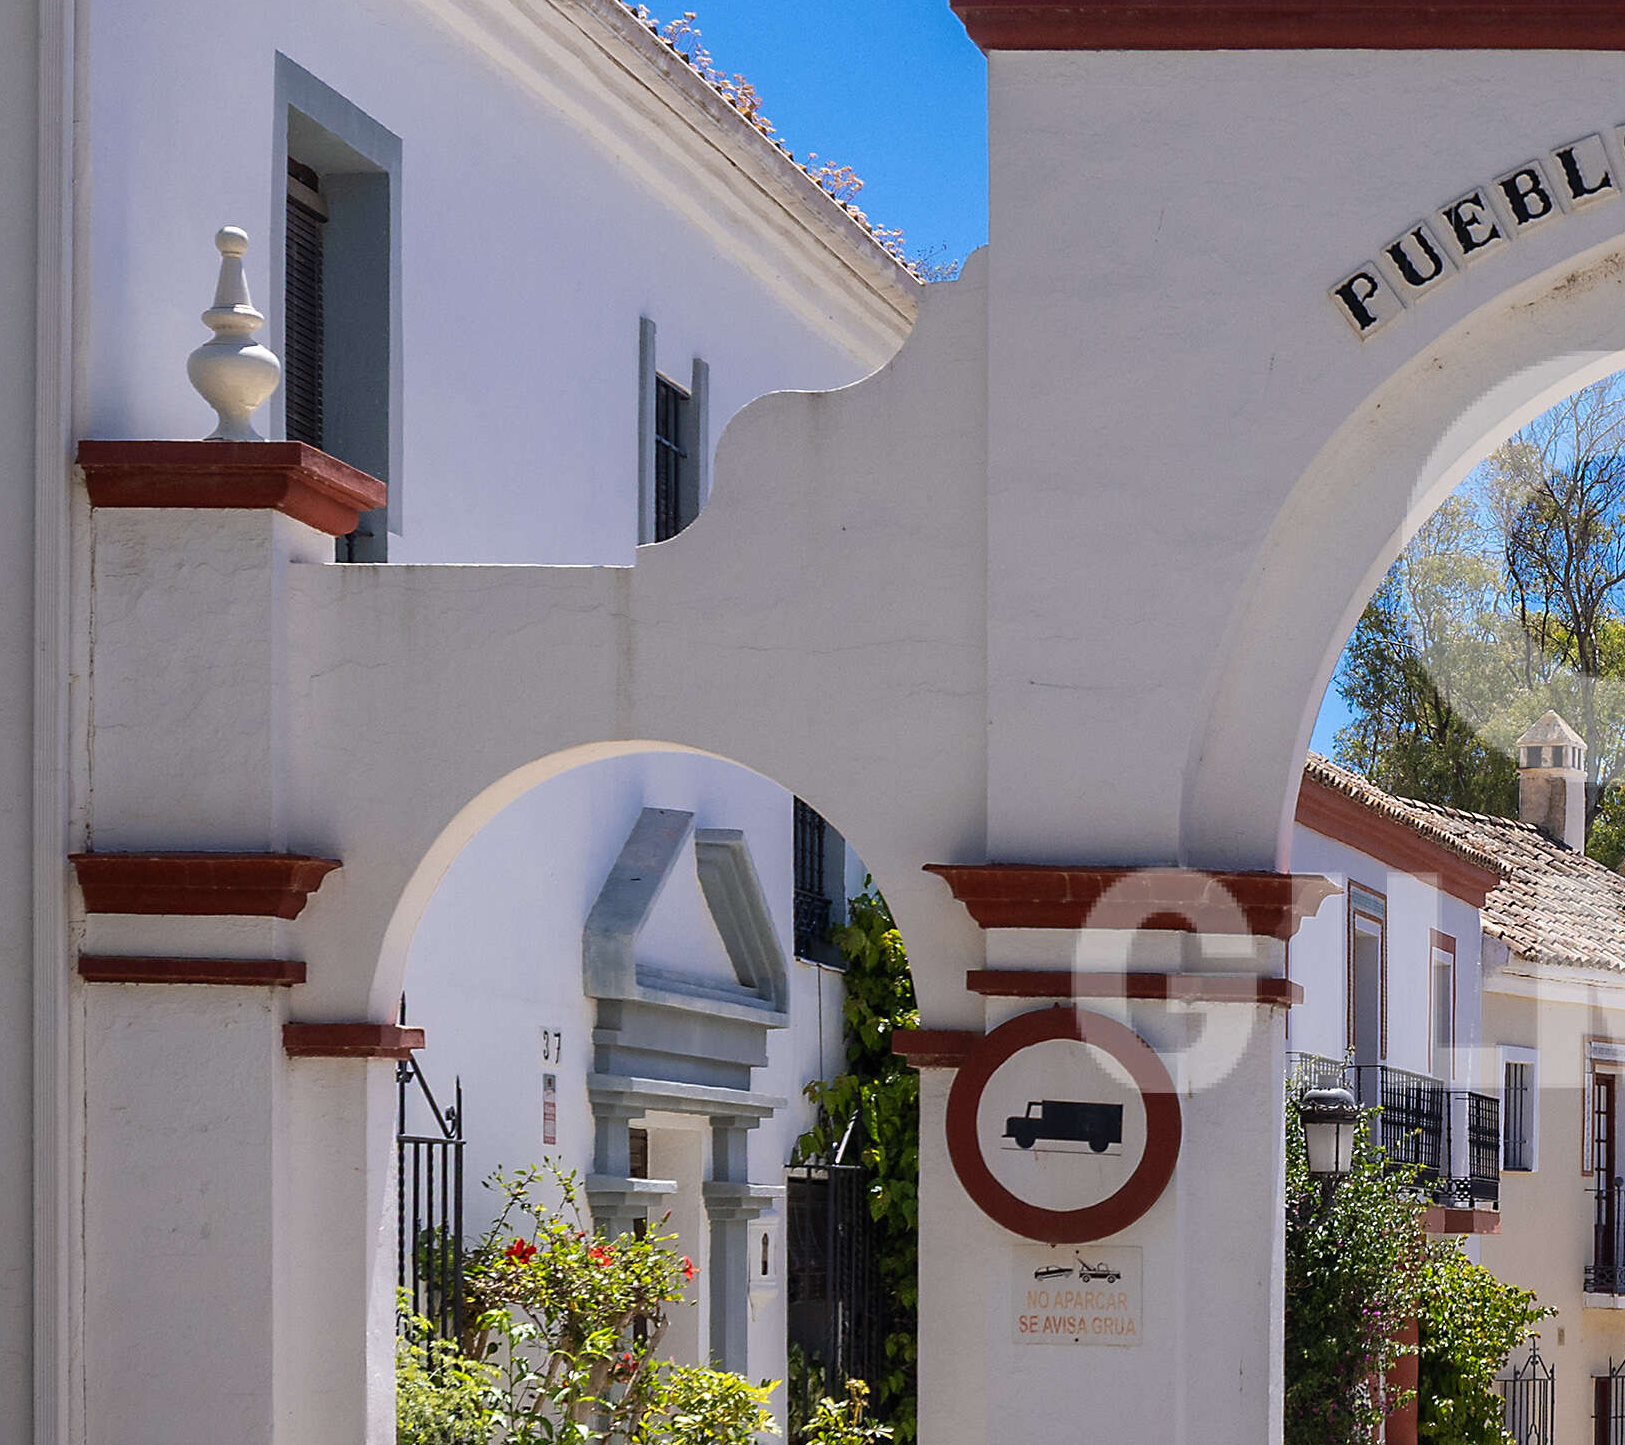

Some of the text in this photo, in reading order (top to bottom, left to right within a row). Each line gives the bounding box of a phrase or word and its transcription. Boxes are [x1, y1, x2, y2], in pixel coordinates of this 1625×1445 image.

[542, 1030, 561, 1064] 37
[1026, 1290, 1128, 1311] NO APARCAR
[1018, 1315, 1136, 1336] SE AVISA GRUA
